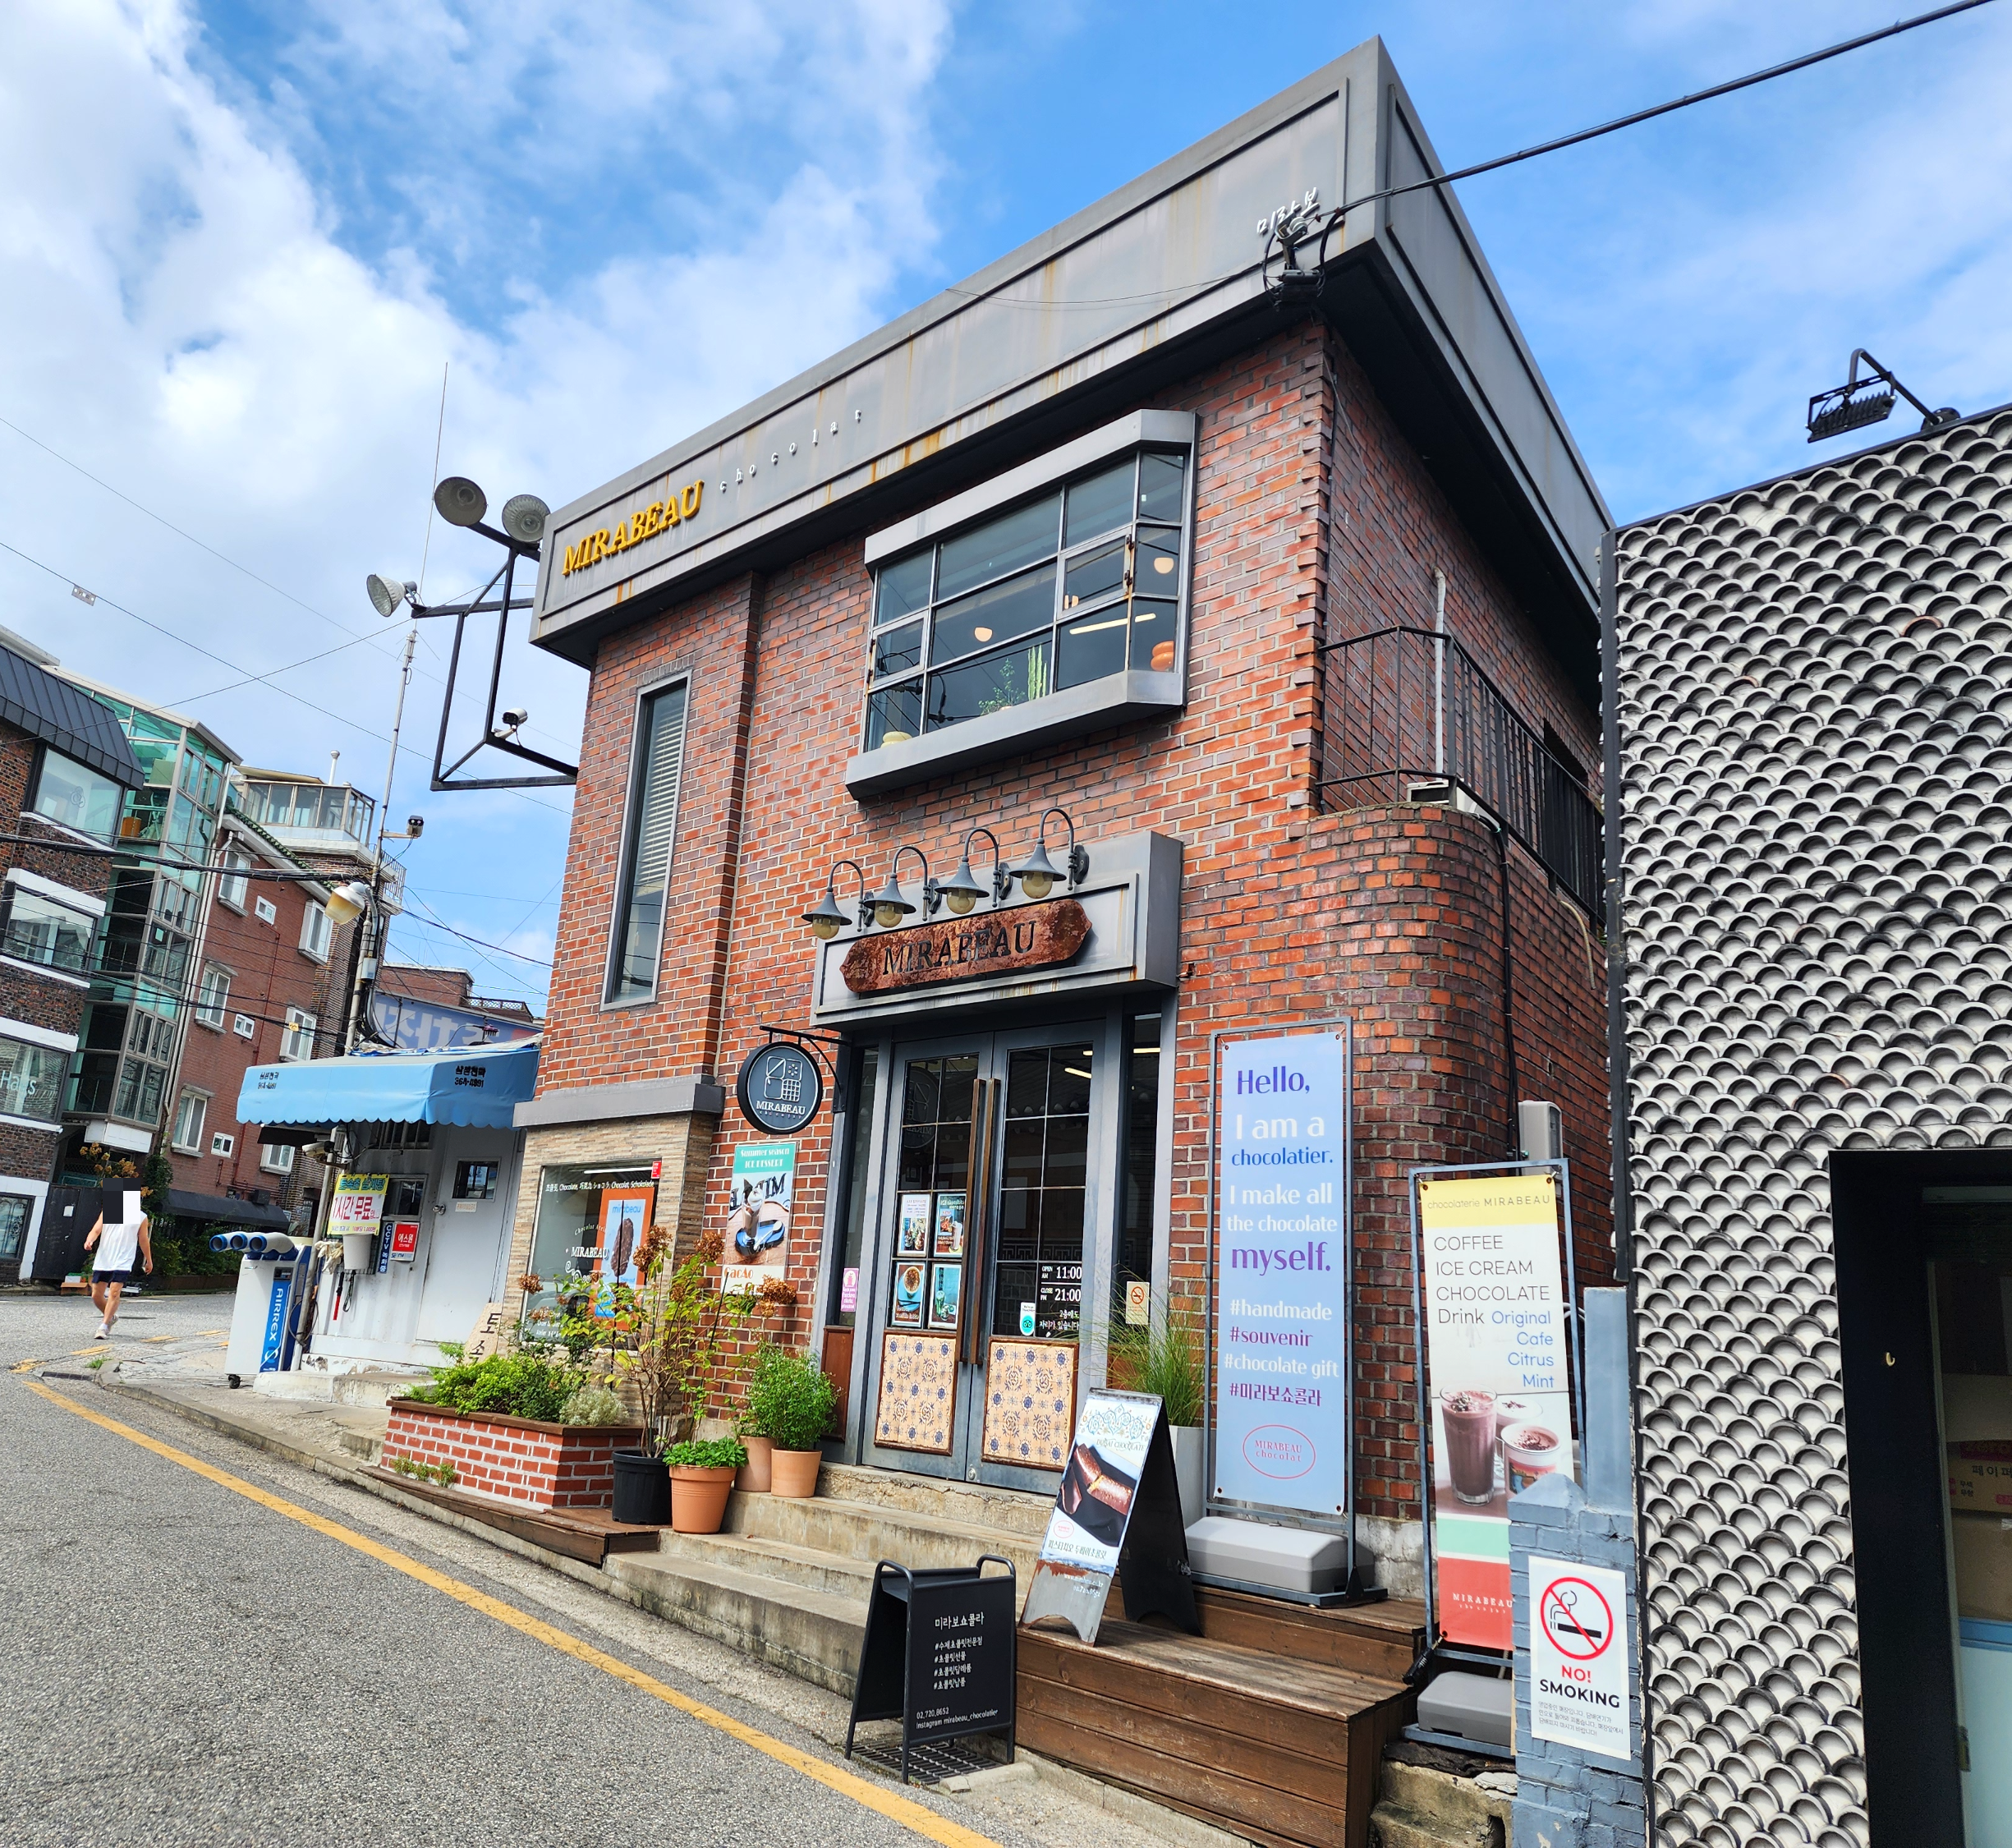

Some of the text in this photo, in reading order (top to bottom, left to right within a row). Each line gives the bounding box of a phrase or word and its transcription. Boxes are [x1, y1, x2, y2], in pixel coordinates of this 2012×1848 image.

[562, 409, 862, 576] MIRABEAU chocolat
[882, 921, 1037, 975] MIRABEAU
[1238, 1066, 1310, 1095] Hello,
[756, 1101, 806, 1115] MIRABEAU
[1236, 1115, 1325, 1139] I am a
[741, 1147, 789, 1157] Summer season
[1232, 1147, 1333, 1166] chocolatier.
[745, 1158, 783, 1168] ICE DESSERT
[1229, 1182, 1332, 1205] I make all
[1427, 1195, 1550, 1210] chocolaterie MIRABEAU
[1226, 1214, 1337, 1232] the chocolate
[384, 1225, 393, 1249] CCTV
[1434, 1235, 1504, 1251] COFFEE
[571, 1246, 609, 1259] MIRABEAU
[1232, 1241, 1330, 1276] myself.
[1056, 1266, 1082, 1280] 11:00
[1436, 1260, 1533, 1276] ICE CREAM
[1054, 1288, 1082, 1302] 21:00
[1436, 1285, 1550, 1301] CHOCOLATE
[269, 1288, 283, 1341] AIRREX
[1229, 1299, 1333, 1321] #handmade
[1438, 1308, 1551, 1327] Drink Original
[1039, 1320, 1080, 1331] 자리가 있습니다
[1229, 1326, 1313, 1347] #souvenir
[1517, 1331, 1554, 1345] Cafe
[1224, 1354, 1339, 1379] #chocolate gift
[1508, 1352, 1554, 1367] Citrus
[1523, 1373, 1555, 1388] Mint
[1229, 1382, 1322, 1407] #미라보쇼콜라
[1255, 1440, 1302, 1454] MIRABEAU
[1256, 1450, 1302, 1462] chocolat
[1453, 1593, 1513, 1608] MIRABEAU
[935, 1611, 985, 1630] 미라보쇼콜라
[935, 1635, 983, 1651] #수제초콜릿전문점
[934, 1651, 967, 1663] #초콜릿선물
[934, 1662, 972, 1677] #초콜릿답례품
[1561, 1664, 1592, 1684] NO!
[1540, 1679, 1620, 1708] SMOKING
